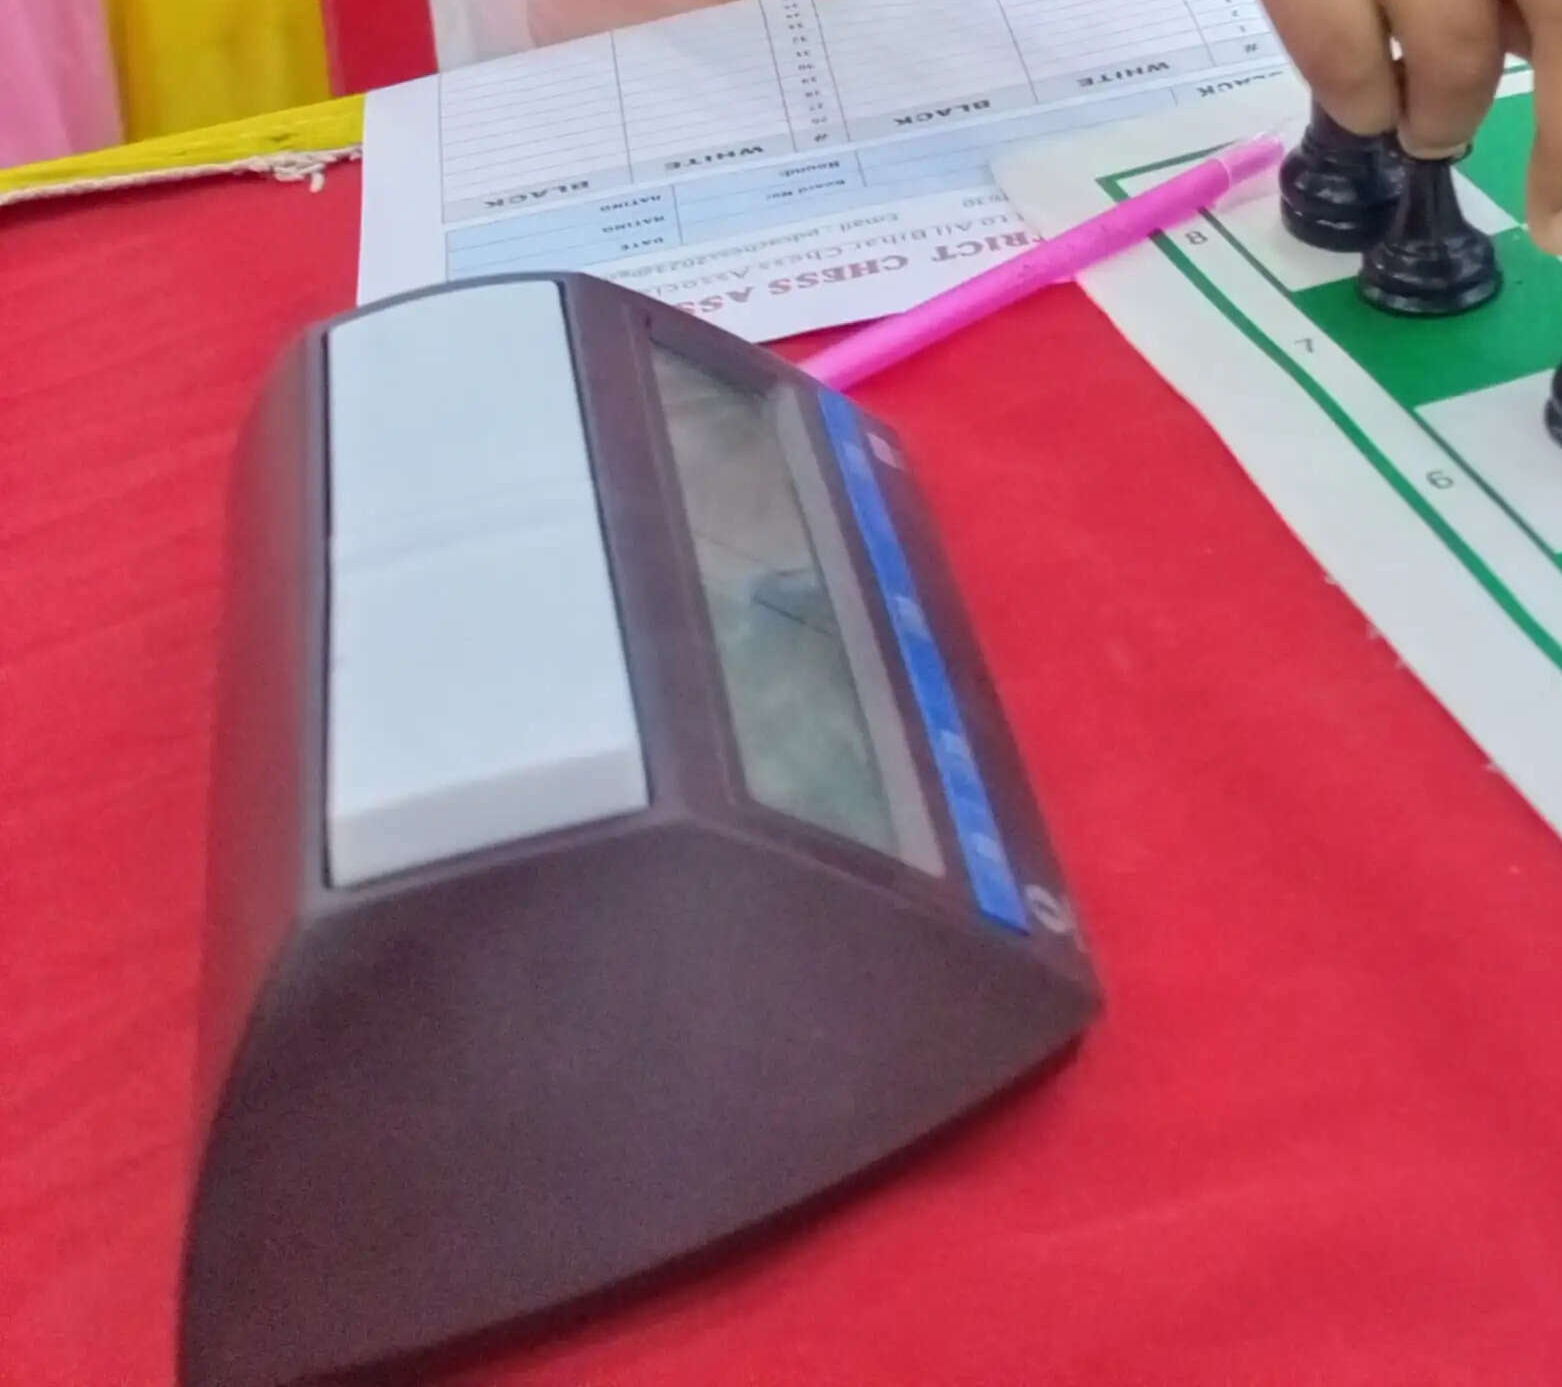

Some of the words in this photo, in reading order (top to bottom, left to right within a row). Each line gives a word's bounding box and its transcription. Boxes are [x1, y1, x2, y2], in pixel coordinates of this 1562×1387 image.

[1077, 61, 1170, 88] WHITE
[1196, 70, 1284, 98] ACK
[893, 99, 991, 126] BLACK
[484, 180, 590, 209] BLACK
[620, 236, 664, 252] DATE
[1184, 229, 1209, 246] 8
[767, 254, 909, 295] CHESS
